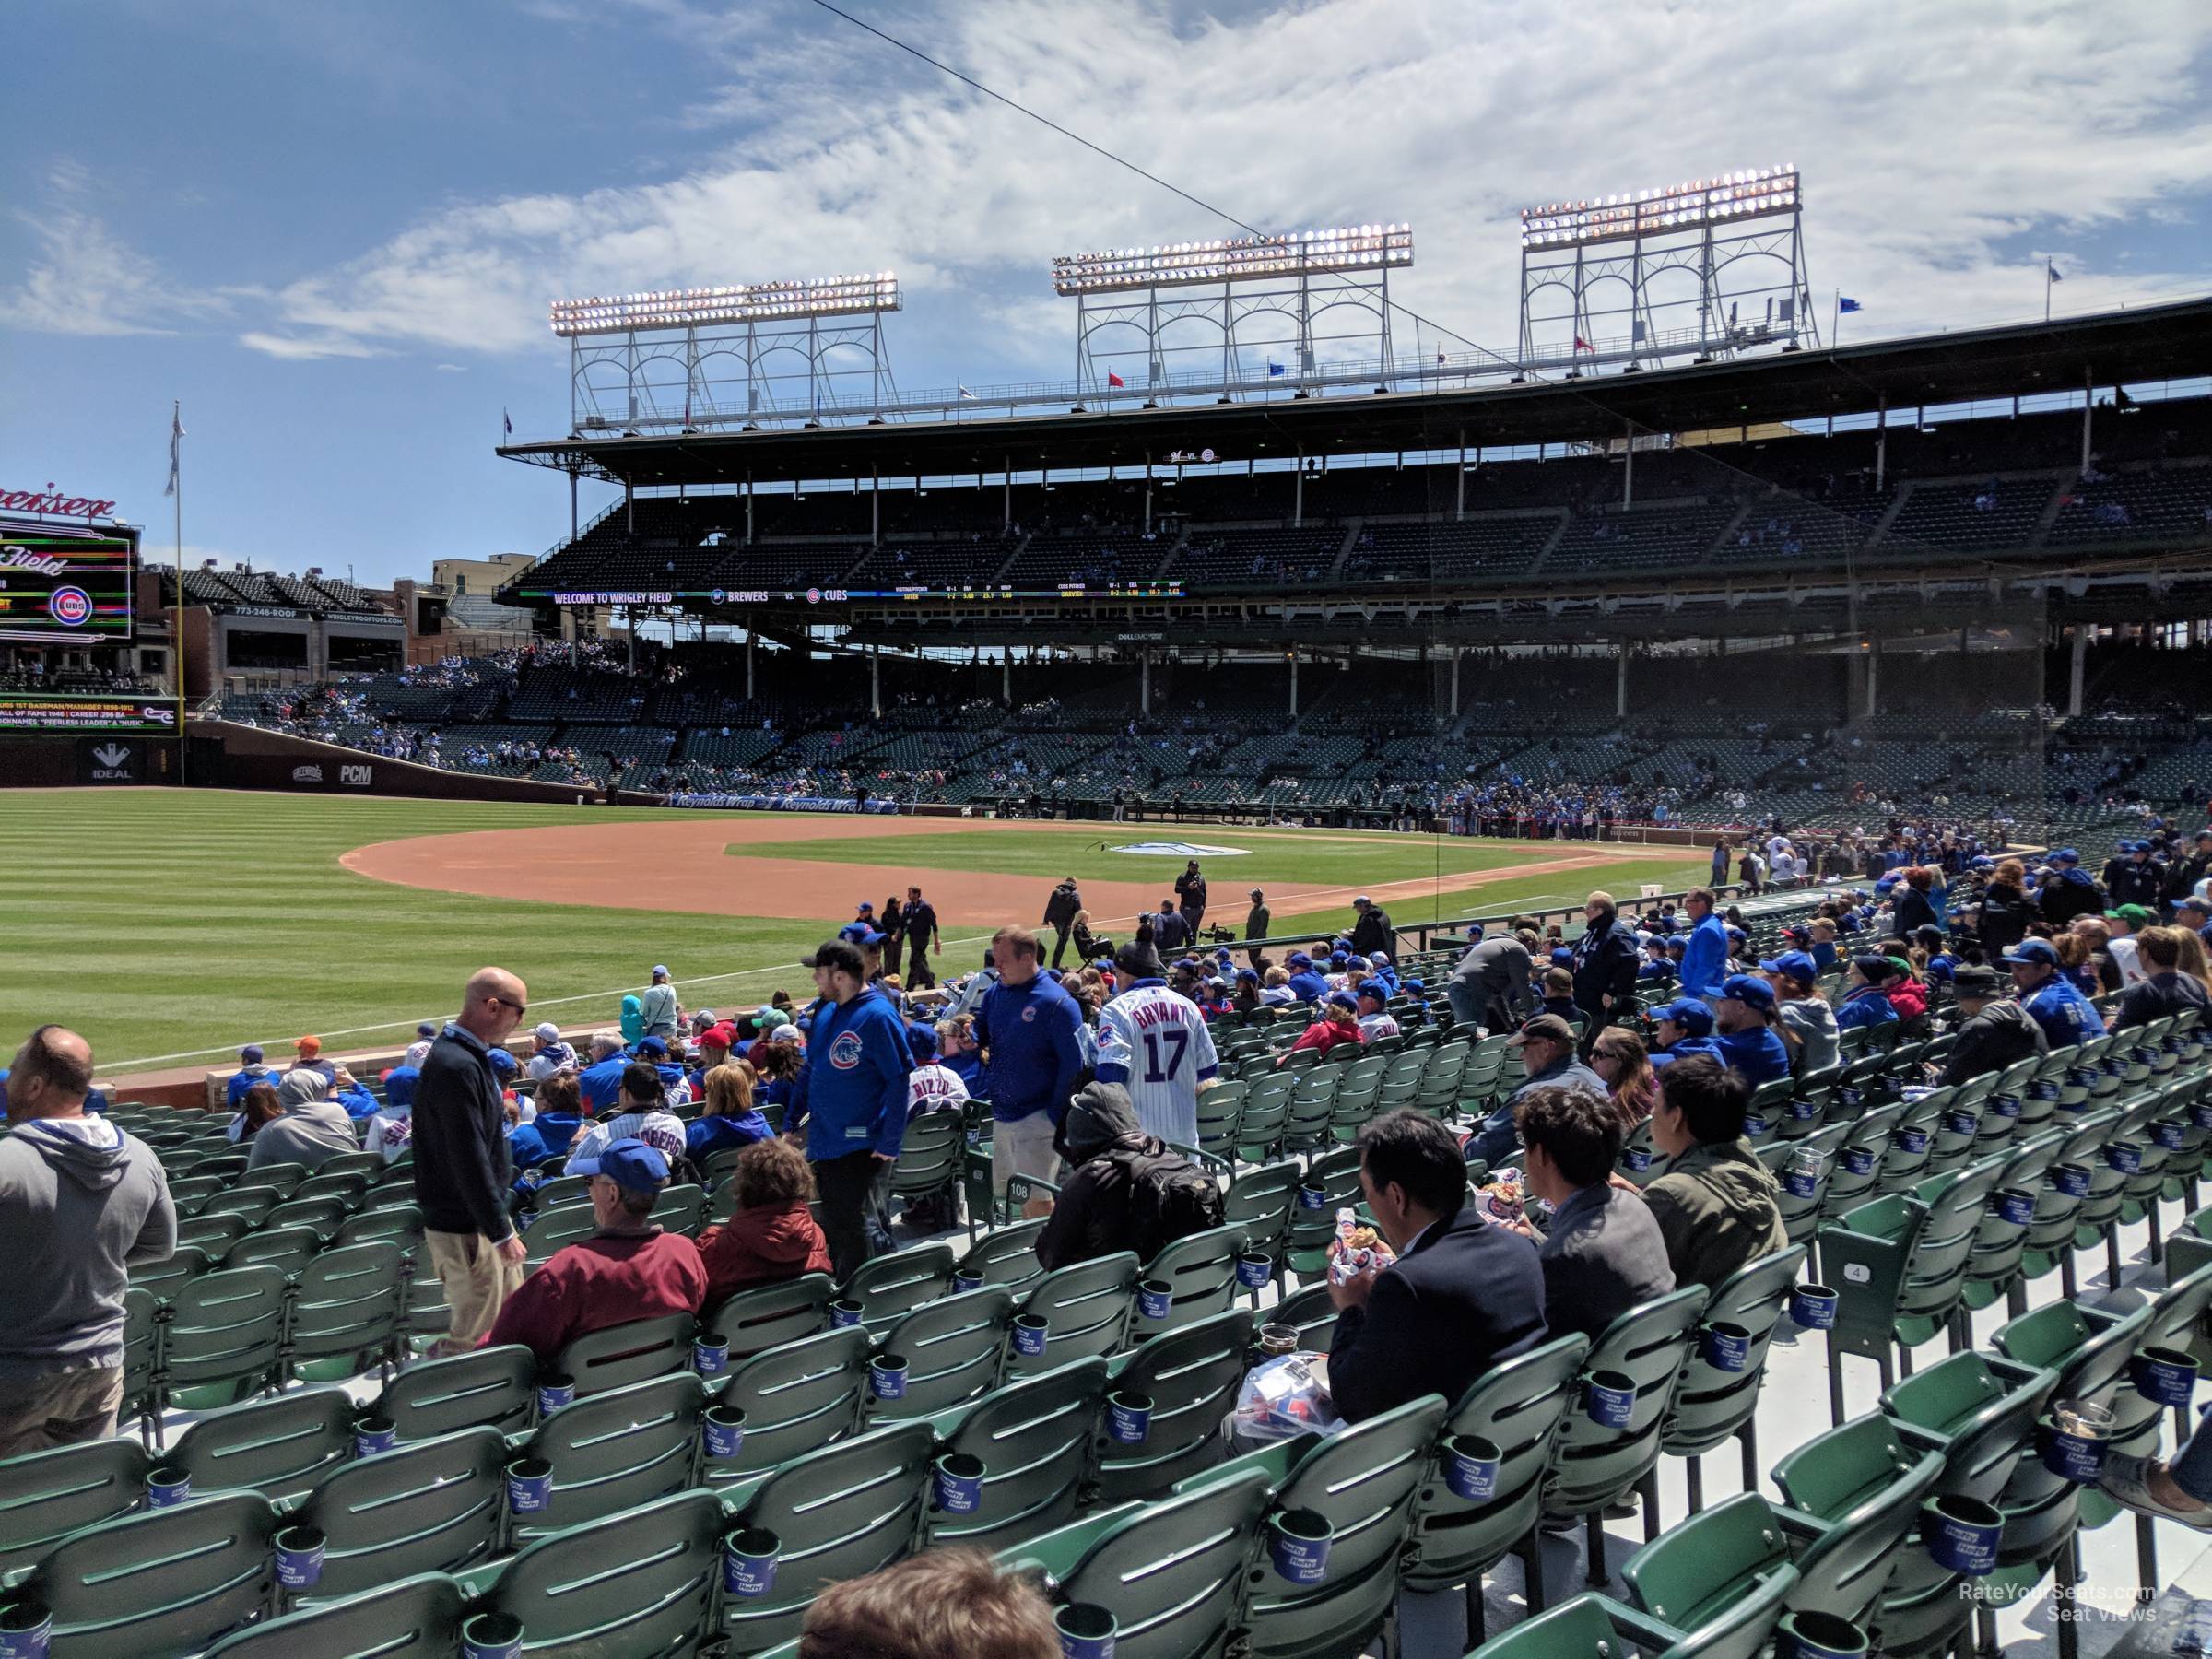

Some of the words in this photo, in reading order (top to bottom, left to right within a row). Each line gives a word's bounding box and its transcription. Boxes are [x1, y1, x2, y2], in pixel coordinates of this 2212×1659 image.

[0, 482, 116, 518] eiser
[555, 593, 595, 605] WELCOME
[597, 593, 608, 604] TO
[610, 592, 647, 604] WRIGLEY
[649, 591, 673, 603] FIELD
[728, 591, 769, 603] BREWERS
[825, 590, 848, 601] CUBS
[235, 606, 297, 618] 773-248-ROOF
[327, 612, 403, 626] WRIGLEYROOFTOPS.COM
[69, 711, 99, 719] CAREER
[93, 769, 131, 780] IDEAL
[340, 765, 373, 782] PCM
[677, 794, 726, 807] Reynolds
[726, 796, 756, 810] Wrap
[782, 798, 830, 811] Reynolds
[831, 800, 863, 814] Wra
[1133, 1002, 1188, 1030] BRYANT
[1143, 1029, 1188, 1083] 17
[913, 1077, 949, 1099] RIZZO
[1011, 1182, 1028, 1199] 108
[1852, 1267, 1861, 1278] 4
